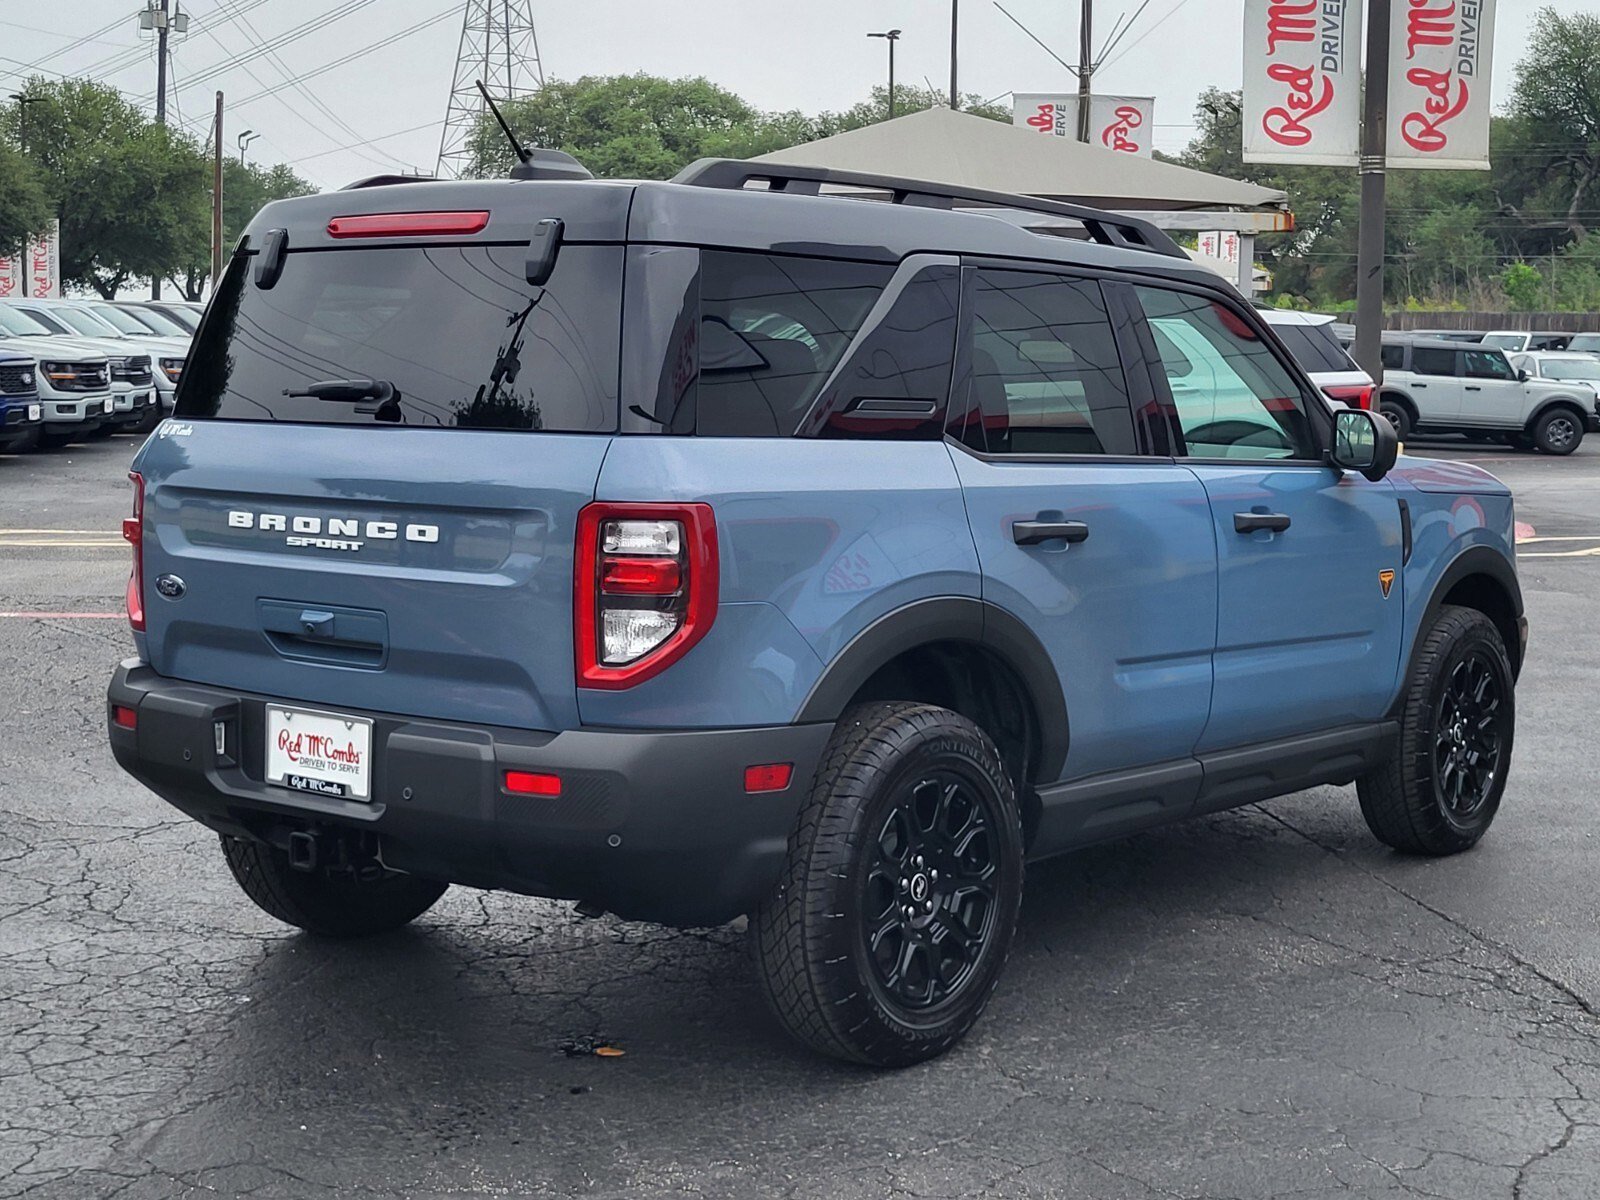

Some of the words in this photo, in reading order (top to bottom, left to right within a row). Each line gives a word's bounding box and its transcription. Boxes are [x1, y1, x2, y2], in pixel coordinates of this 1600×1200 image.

[1320, 0, 1340, 74] DRIVE
[1055, 104, 1066, 136] ERVE
[1263, 63, 1334, 146] Red
[1401, 67, 1469, 152] Red
[1102, 106, 1142, 153] Red
[33, 277, 52, 298] Red
[228, 510, 439, 543] BRONCO
[286, 536, 364, 551] SPORT
[278, 729, 302, 762] Red
[304, 732, 360, 764] McCombs
[299, 757, 326, 769] DRIVEN
[327, 761, 337, 771] TO
[338, 764, 360, 775] SERVE
